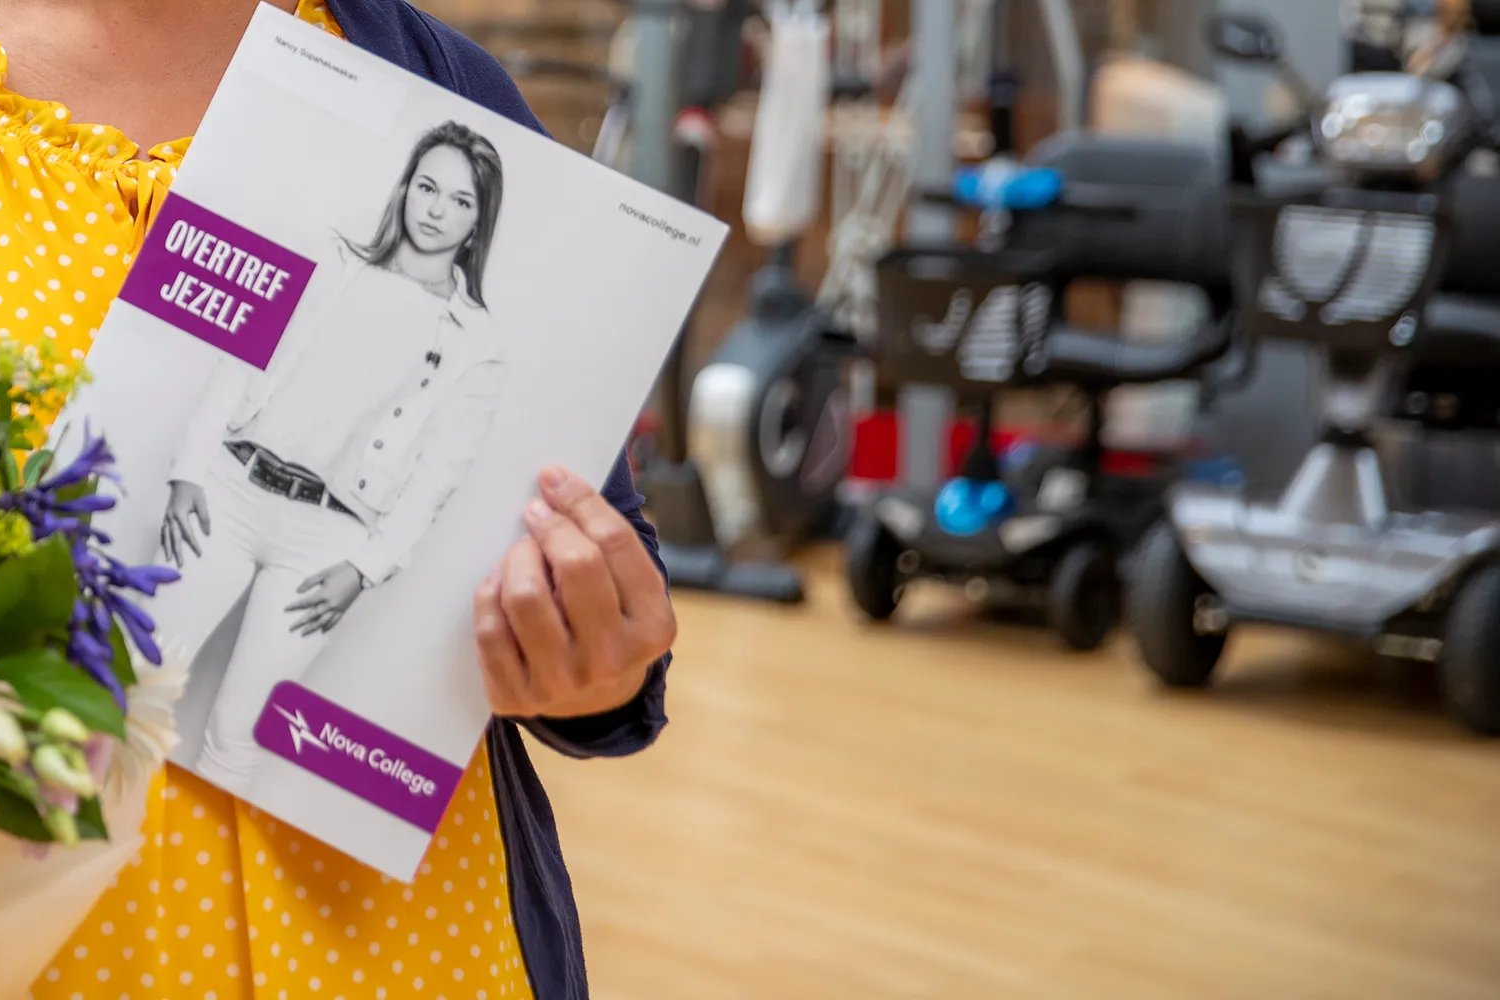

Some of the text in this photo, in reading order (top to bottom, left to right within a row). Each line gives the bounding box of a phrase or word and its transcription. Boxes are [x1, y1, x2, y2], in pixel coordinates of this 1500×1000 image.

[274, 35, 299, 53] Nancy
[618, 202, 701, 247] novacollege.nl
[164, 219, 291, 302] OVERTREF
[159, 270, 255, 335] JEZELF
[319, 721, 437, 797] Nova College
